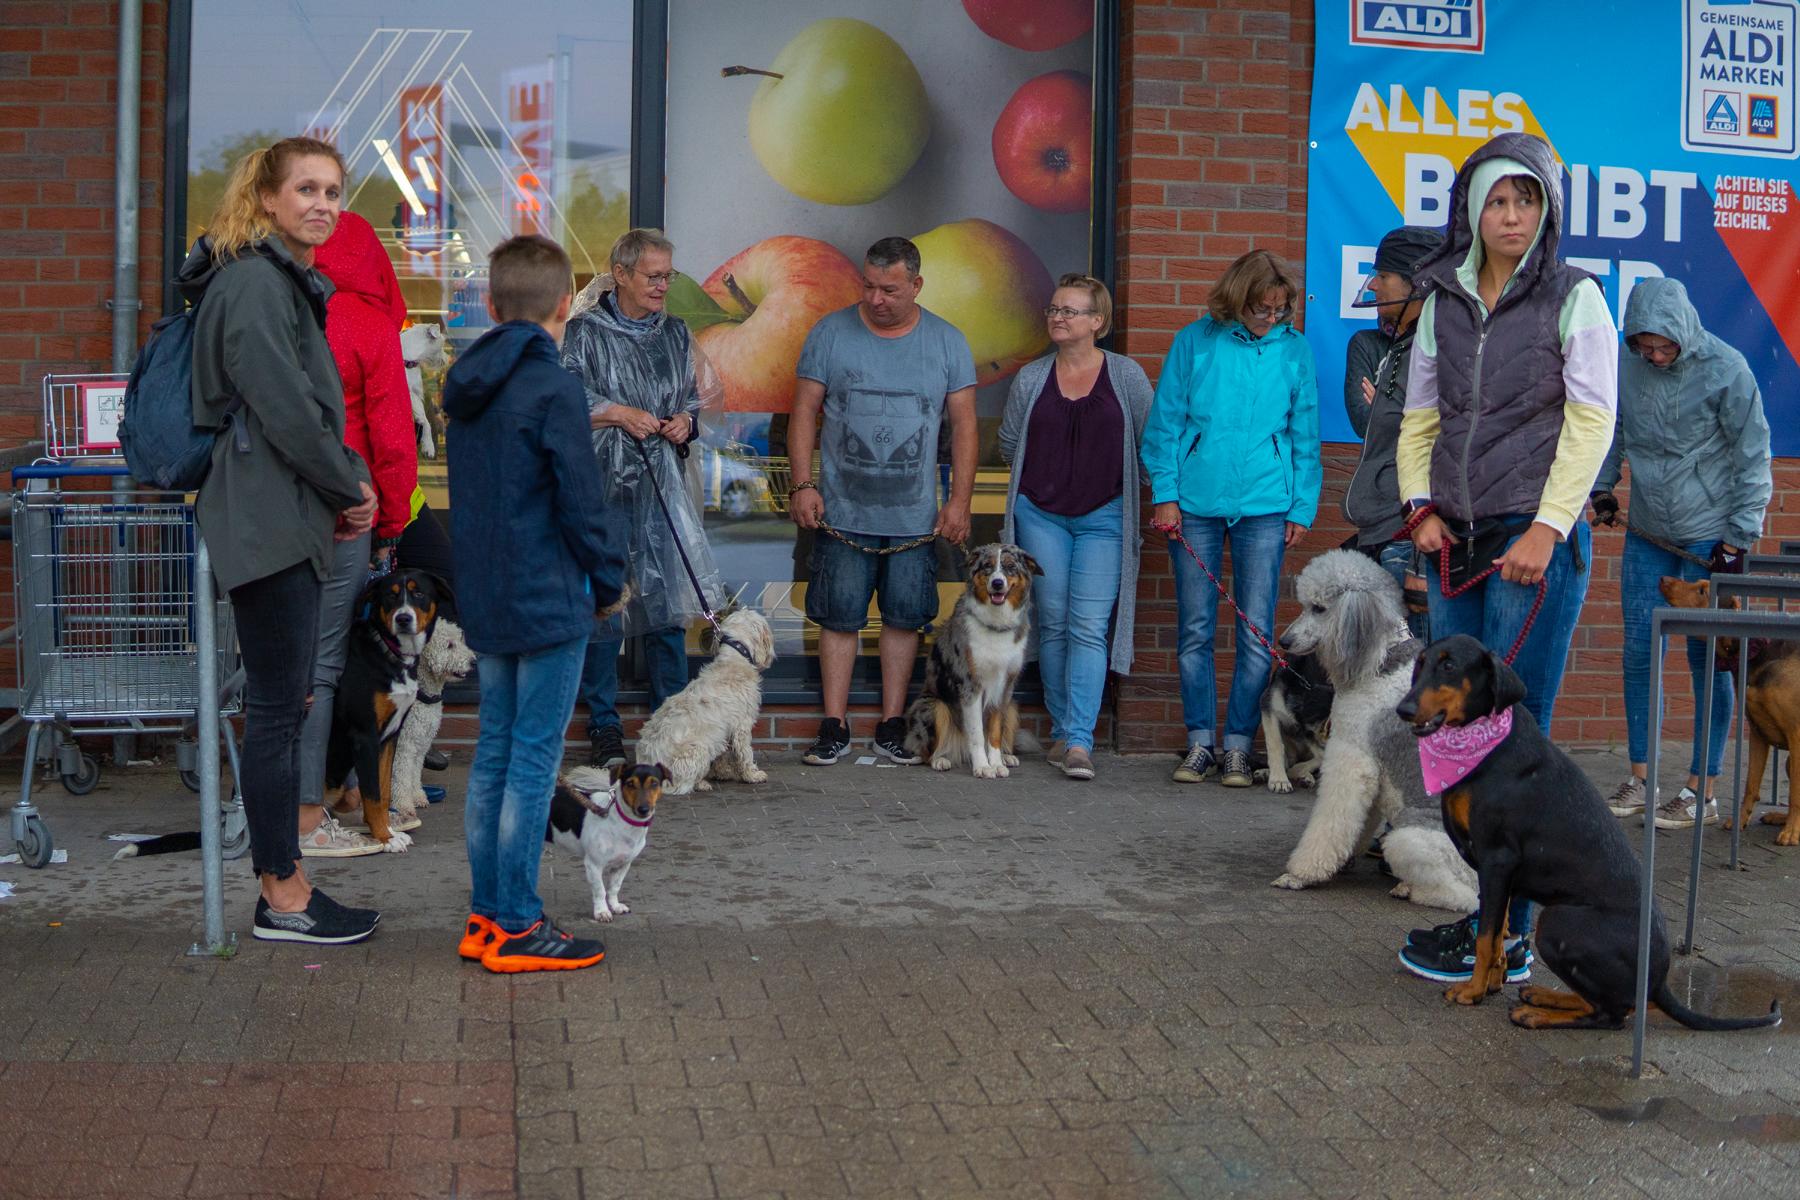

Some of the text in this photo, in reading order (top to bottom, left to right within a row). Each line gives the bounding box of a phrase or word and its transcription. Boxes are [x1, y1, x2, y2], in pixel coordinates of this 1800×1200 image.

[1373, 6, 1462, 35] ALDI
[1700, 12, 1784, 31] GEMEINSAME
[1700, 27, 1784, 66] ALDI
[1700, 62, 1784, 87] MARKEN
[1344, 82, 1524, 138] ALLES
[1709, 121, 1736, 131] ALDI
[1752, 118, 1774, 128] ALDI
[1714, 174, 1789, 195] ACHTEN SIE
[1404, 152, 1697, 242] BIBT
[1714, 192, 1788, 214] AUF DIESES
[1713, 211, 1772, 231] ZEICHEN.
[875, 432, 890, 444] 66
